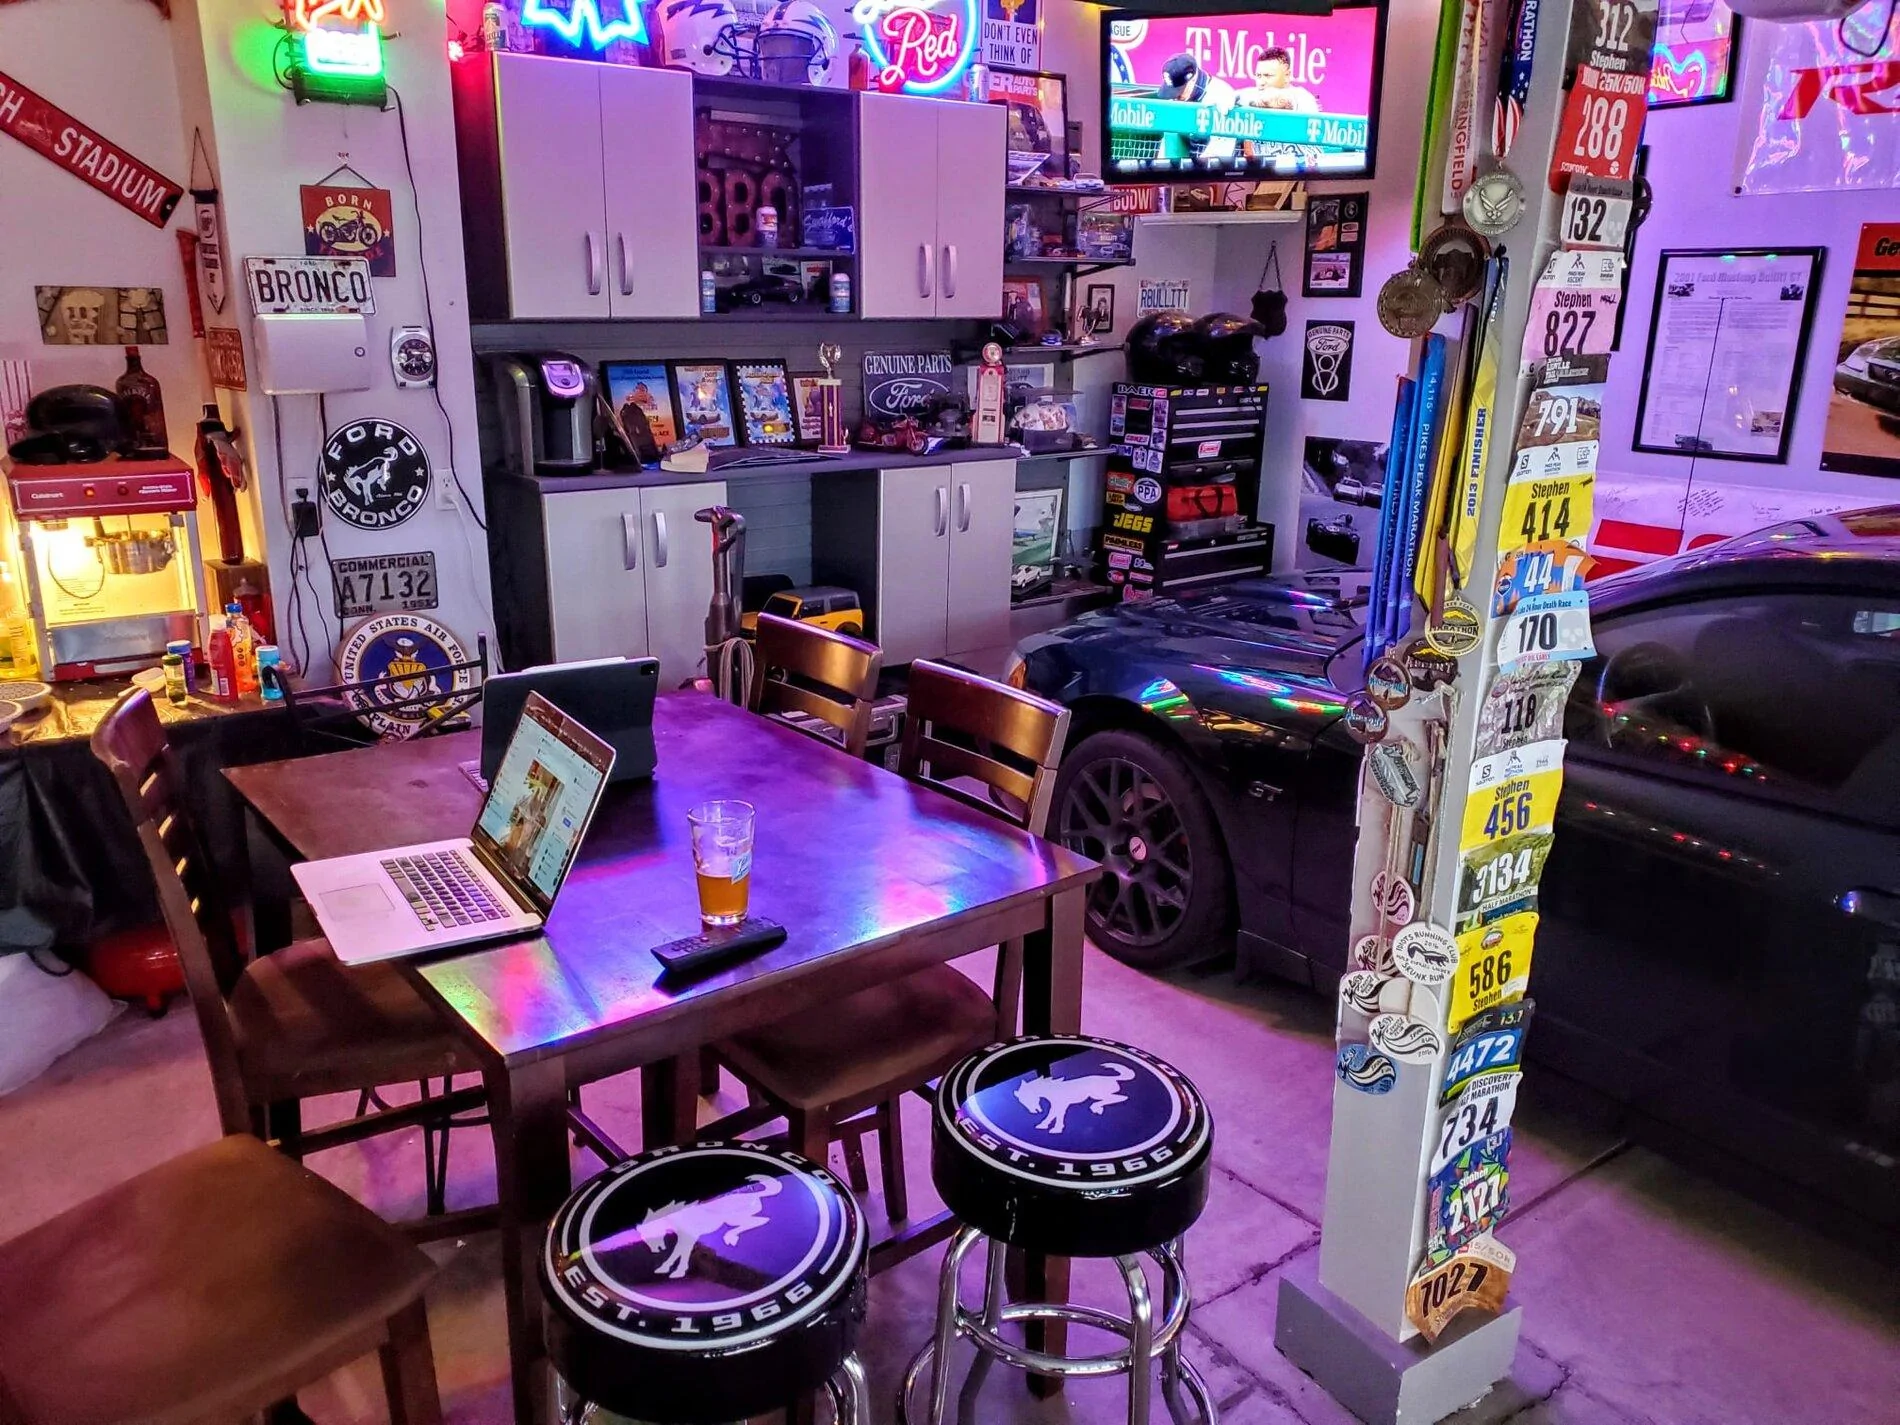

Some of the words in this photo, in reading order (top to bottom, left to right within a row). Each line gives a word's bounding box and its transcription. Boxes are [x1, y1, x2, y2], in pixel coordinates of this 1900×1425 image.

[984, 22, 1011, 41] DON'T
[1015, 27, 1038, 45] EVEN
[1112, 24, 1131, 37] GUE
[1595, 2, 1634, 51] 312
[881, 7, 959, 85] Red
[989, 43, 1016, 63] THINK
[1020, 47, 1032, 64] OF
[1590, 50, 1627, 70] Stephen
[1213, 113, 1264, 138] Mobile
[1574, 94, 1628, 160] 288
[0, 80, 25, 124] H
[54, 127, 168, 214] STADIUM
[325, 193, 373, 210] BORN
[1568, 197, 1607, 242] 132
[255, 269, 367, 304] BRONCO
[1554, 290, 1592, 309] Stephen
[1314, 339, 1341, 352] Ford
[1544, 310, 1597, 357] 827
[864, 355, 915, 376] GENUINE
[917, 354, 952, 374] PARTS
[1534, 398, 1579, 438] 791
[328, 423, 418, 461] FORD
[1416, 423, 1431, 460] PIKES
[1471, 407, 1487, 478] FINISHER
[1138, 485, 1157, 498] PPA
[1414, 462, 1425, 500] PEAK
[1532, 481, 1570, 499] Stephen
[329, 485, 424, 526] BRONCO
[1467, 482, 1479, 518] 2013
[1113, 512, 1154, 534] JEGS
[1521, 497, 1571, 543] 414
[1405, 502, 1421, 578] MARATHON
[339, 555, 429, 574] COMMERCIAL
[1524, 553, 1554, 593] 44
[341, 570, 432, 604] A7132
[1543, 600, 1557, 610] Death
[1558, 598, 1572, 608] Race
[343, 605, 377, 616] CONN.
[345, 633, 367, 680] UNITED
[369, 616, 418, 634] STATES
[424, 622, 447, 642] AIR
[448, 644, 468, 684] FORCE
[1518, 612, 1558, 654] 170
[1501, 693, 1537, 734] 118
[1249, 780, 1284, 801] GT
[1495, 779, 1530, 801] Stephen
[1483, 792, 1533, 841] 456
[1472, 847, 1533, 904] 3134
[1482, 901, 1499, 912] HALF
[1499, 889, 1532, 907] MARATHON
[1396, 933, 1414, 951] IDIOTS
[1414, 930, 1449, 947] RUNNING
[1447, 944, 1459, 964] CLUB
[1402, 963, 1428, 981] SKUNK
[1429, 973, 1445, 982] RUN
[1469, 950, 1512, 1000] 586
[1472, 990, 1502, 1013] Stephen
[1499, 1009, 1524, 1026] 13.1
[1446, 1034, 1516, 1083] 4472
[1470, 1081, 1511, 1103] MARATHON
[1471, 1073, 1513, 1091] DISCOVERY
[1442, 1097, 1498, 1160] 734
[958, 1117, 1036, 1168] EST.
[1056, 1145, 1174, 1177] 1966
[1449, 1173, 1502, 1236] 2127
[564, 1266, 647, 1328] EST.
[671, 1281, 814, 1334] 1966
[1420, 1262, 1488, 1319] 7027
